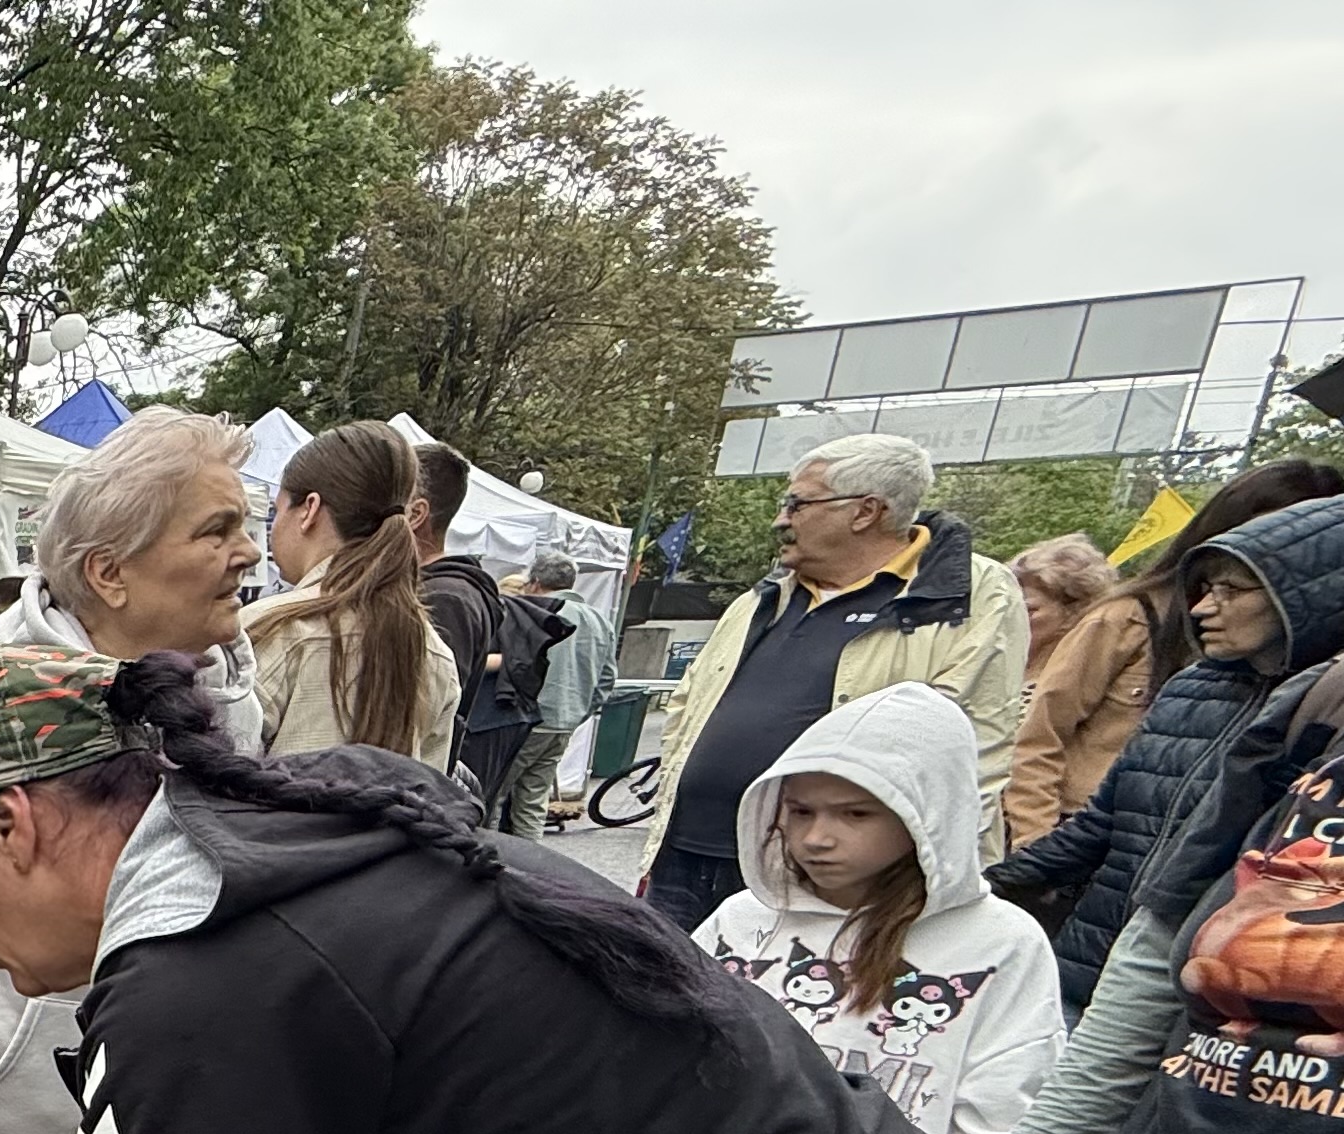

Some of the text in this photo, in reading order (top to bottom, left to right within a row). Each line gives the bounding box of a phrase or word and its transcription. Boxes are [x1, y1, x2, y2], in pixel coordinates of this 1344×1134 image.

[1313, 817, 1344, 845] C
[1193, 1061, 1239, 1097] THE
[1251, 1050, 1329, 1083] AND
